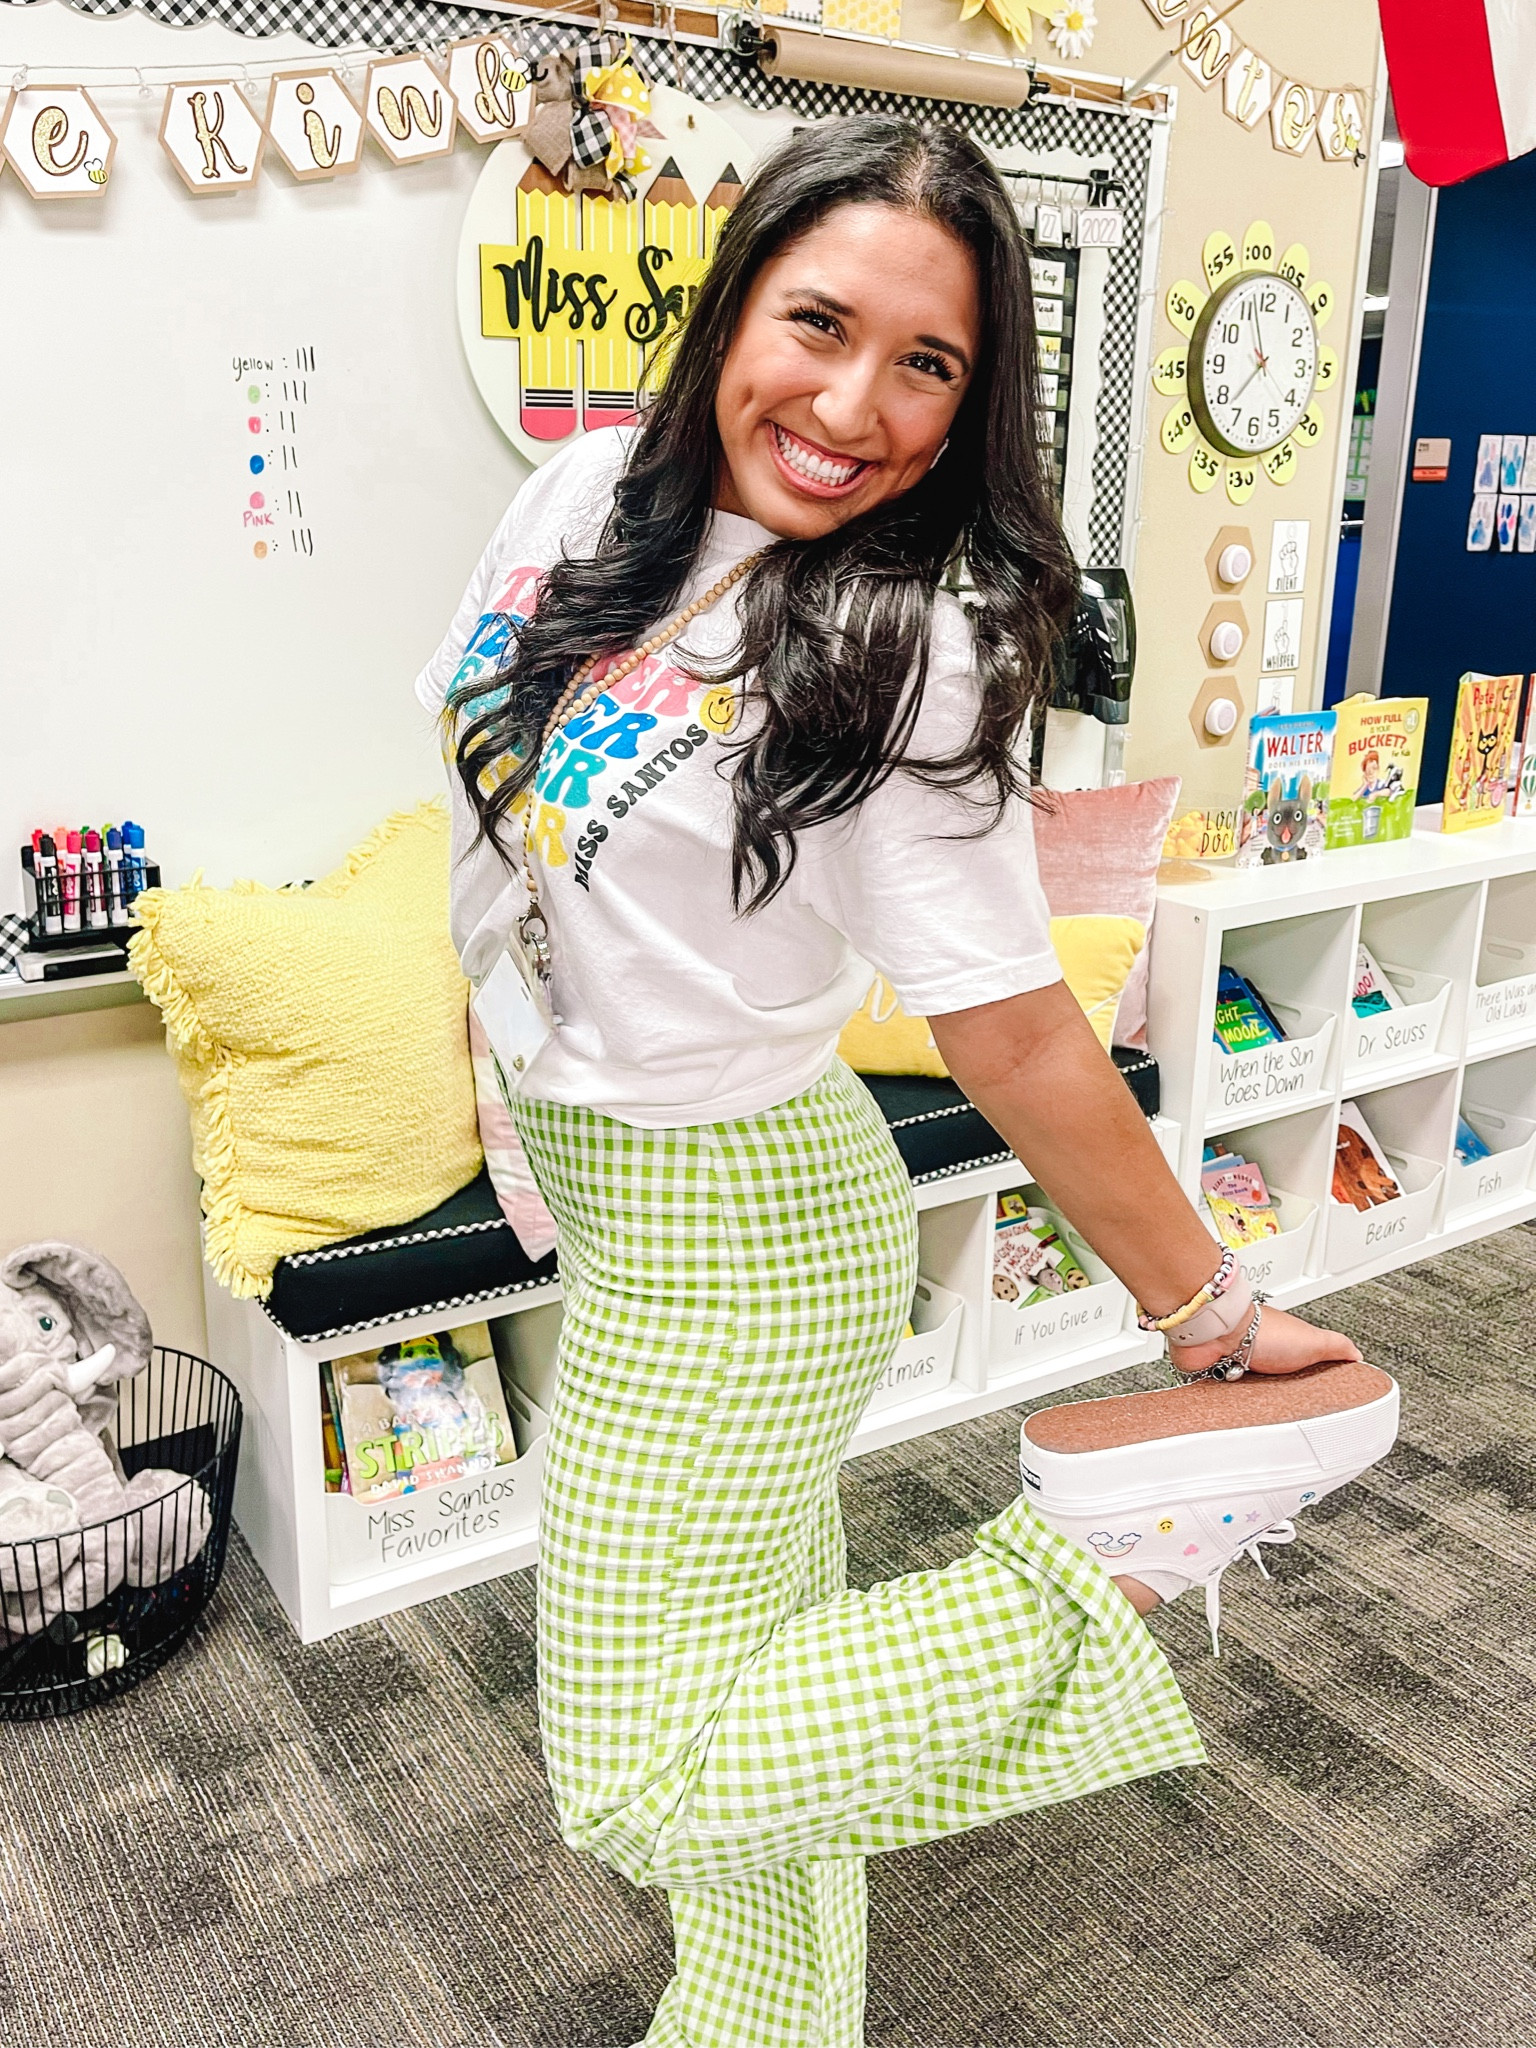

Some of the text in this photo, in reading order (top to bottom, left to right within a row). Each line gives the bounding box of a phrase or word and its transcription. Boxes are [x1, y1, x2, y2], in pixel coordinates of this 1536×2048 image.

[1082, 217, 1118, 244] 2022
[1207, 245, 1235, 277] :55
[1245, 244, 1272, 261] :00
[493, 235, 619, 333] Miss
[1280, 262, 1306, 289] :05
[1170, 292, 1195, 321] :50
[1259, 292, 1277, 313] 12
[1284, 303, 1291, 324] 1
[1222, 323, 1240, 345] 10
[1291, 327, 1303, 348] 2
[1159, 360, 1185, 379] :45
[1212, 354, 1226, 375] 9
[1294, 358, 1306, 379] 3
[1216, 385, 1229, 405] 8
[1284, 388, 1296, 407] 4
[1168, 411, 1192, 443] :40
[1231, 407, 1242, 427] 7
[1247, 416, 1259, 437] 6
[1267, 409, 1280, 428] 5
[1194, 449, 1219, 477] :35
[1268, 443, 1293, 474] :25
[1229, 471, 1254, 488] :30
[1266, 654, 1295, 669] WHISPER
[1472, 686, 1495, 707] Pete
[1360, 715, 1382, 727] HOW
[1383, 713, 1402, 724] FULL
[1267, 731, 1324, 758] WALTER
[1348, 733, 1408, 757] BUCKET?
[573, 723, 709, 892] MISS SANTOS
[1476, 991, 1501, 1009] There
[1504, 984, 1526, 1001] Was
[1485, 1000, 1528, 1023] Old Lady
[1223, 1020, 1262, 1044] MOON
[1357, 1023, 1427, 1058] Dr Seuss
[1220, 1046, 1314, 1083] When the Sun
[1224, 1073, 1304, 1106] Goes Down
[1477, 1171, 1503, 1197] Fish
[1365, 1215, 1407, 1246] Bears
[1014, 1305, 1103, 1346] If You Give a
[368, 1478, 516, 1540] Miss Santos
[380, 1509, 502, 1564] Favorites
